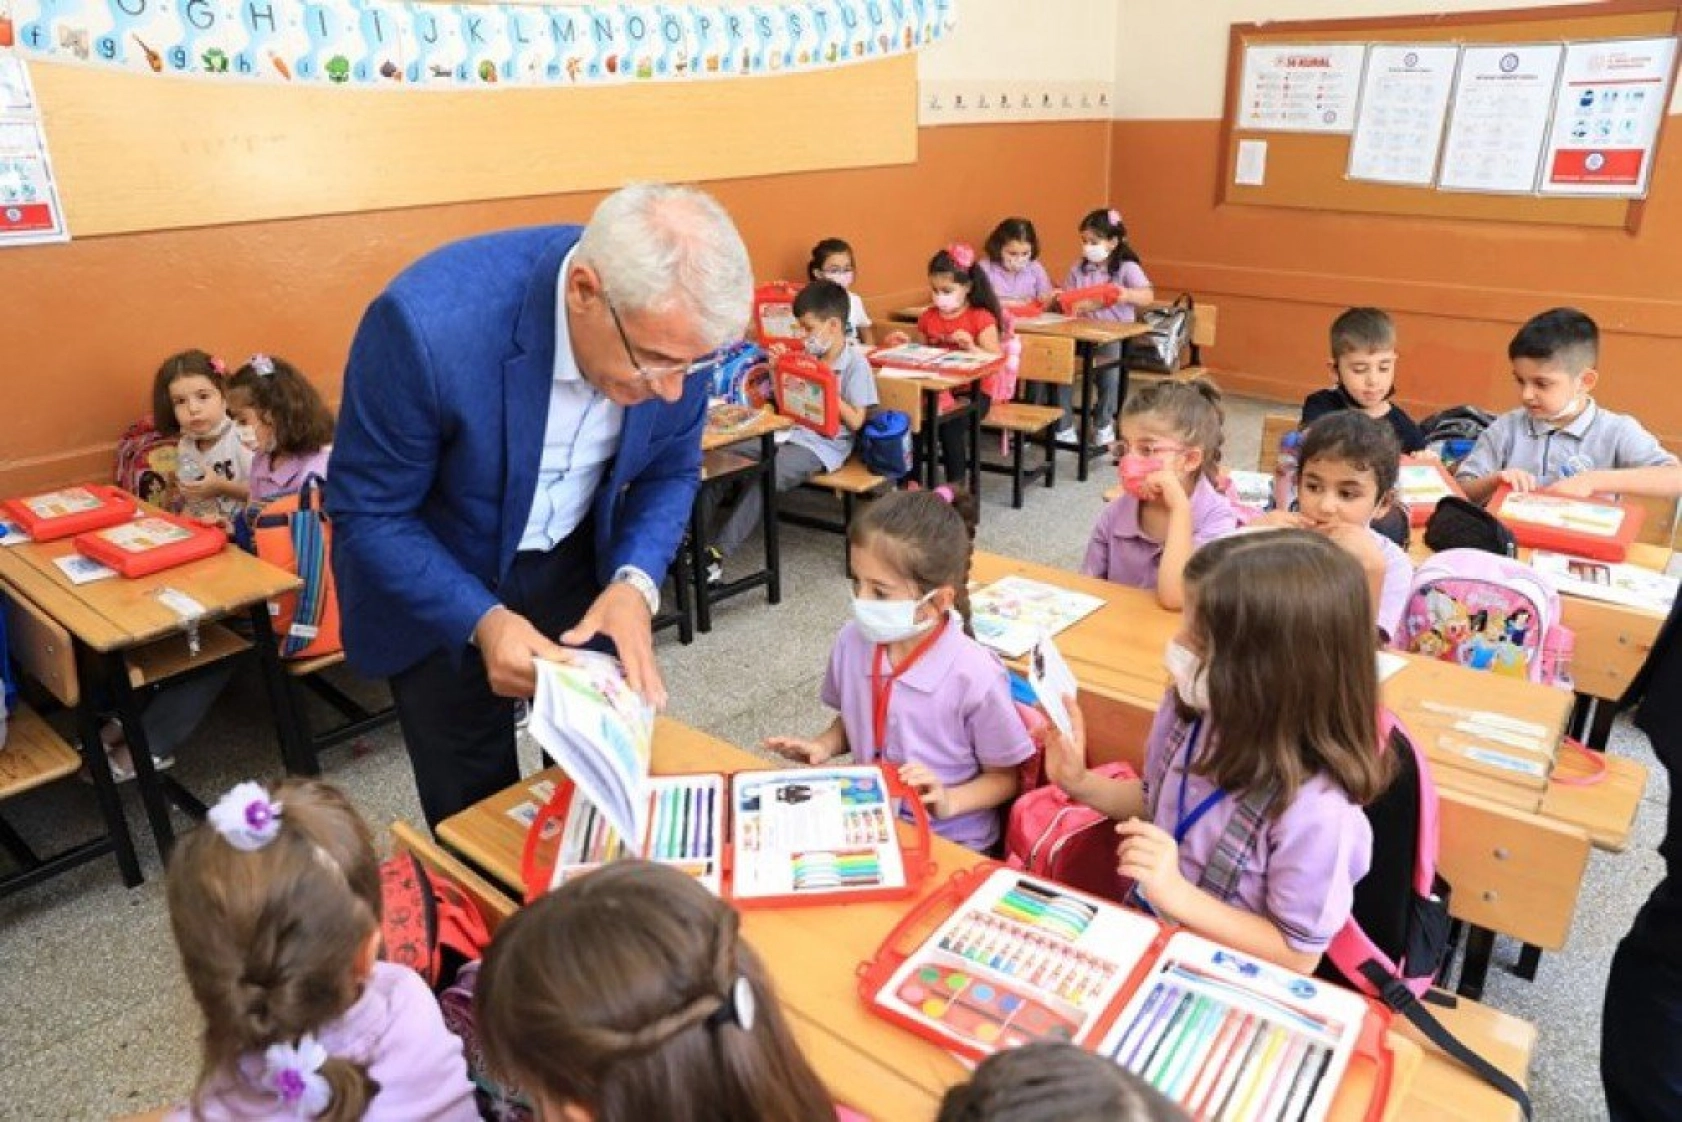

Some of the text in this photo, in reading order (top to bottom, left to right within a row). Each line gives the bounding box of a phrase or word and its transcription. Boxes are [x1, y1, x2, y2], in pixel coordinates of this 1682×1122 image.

[251, 3, 275, 32] H
[318, 10, 327, 36] I
[423, 18, 437, 43] J
[468, 18, 485, 42] K
[513, 17, 530, 43] L
[552, 18, 575, 42] M
[595, 18, 613, 41] N
[629, 16, 645, 39] O
[700, 16, 710, 38] P
[730, 16, 743, 37] R
[759, 16, 772, 37] S
[31, 25, 41, 46] f
[102, 38, 116, 59] g
[239, 54, 251, 72] h
